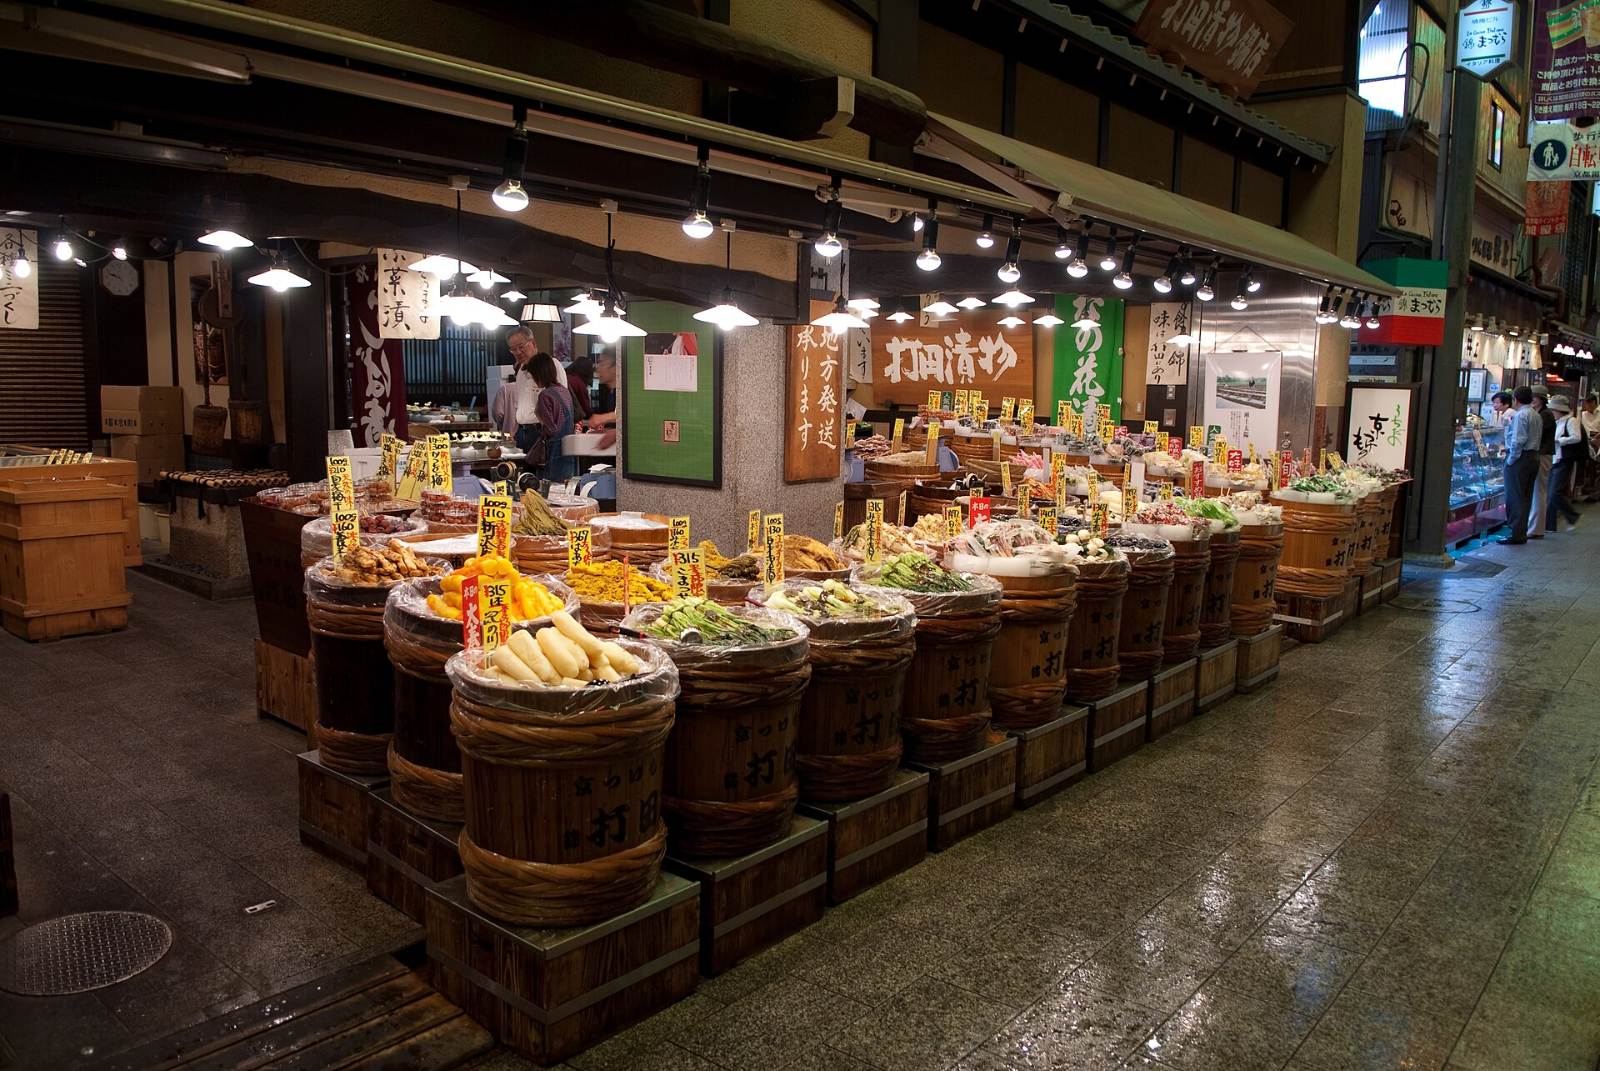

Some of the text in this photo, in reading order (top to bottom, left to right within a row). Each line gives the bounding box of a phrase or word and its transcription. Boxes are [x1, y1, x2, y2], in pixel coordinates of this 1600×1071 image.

[1410, 298, 1442, 314] まつむら
[884, 327, 1018, 385] 打田漬物
[797, 326, 816, 451] 承ります
[818, 326, 838, 450] 地方発送
[330, 457, 348, 466] 100g
[484, 497, 508, 509] 100g
[335, 513, 357, 522] 100g
[673, 552, 700, 565] ¥315
[483, 585, 509, 597] ¥315
